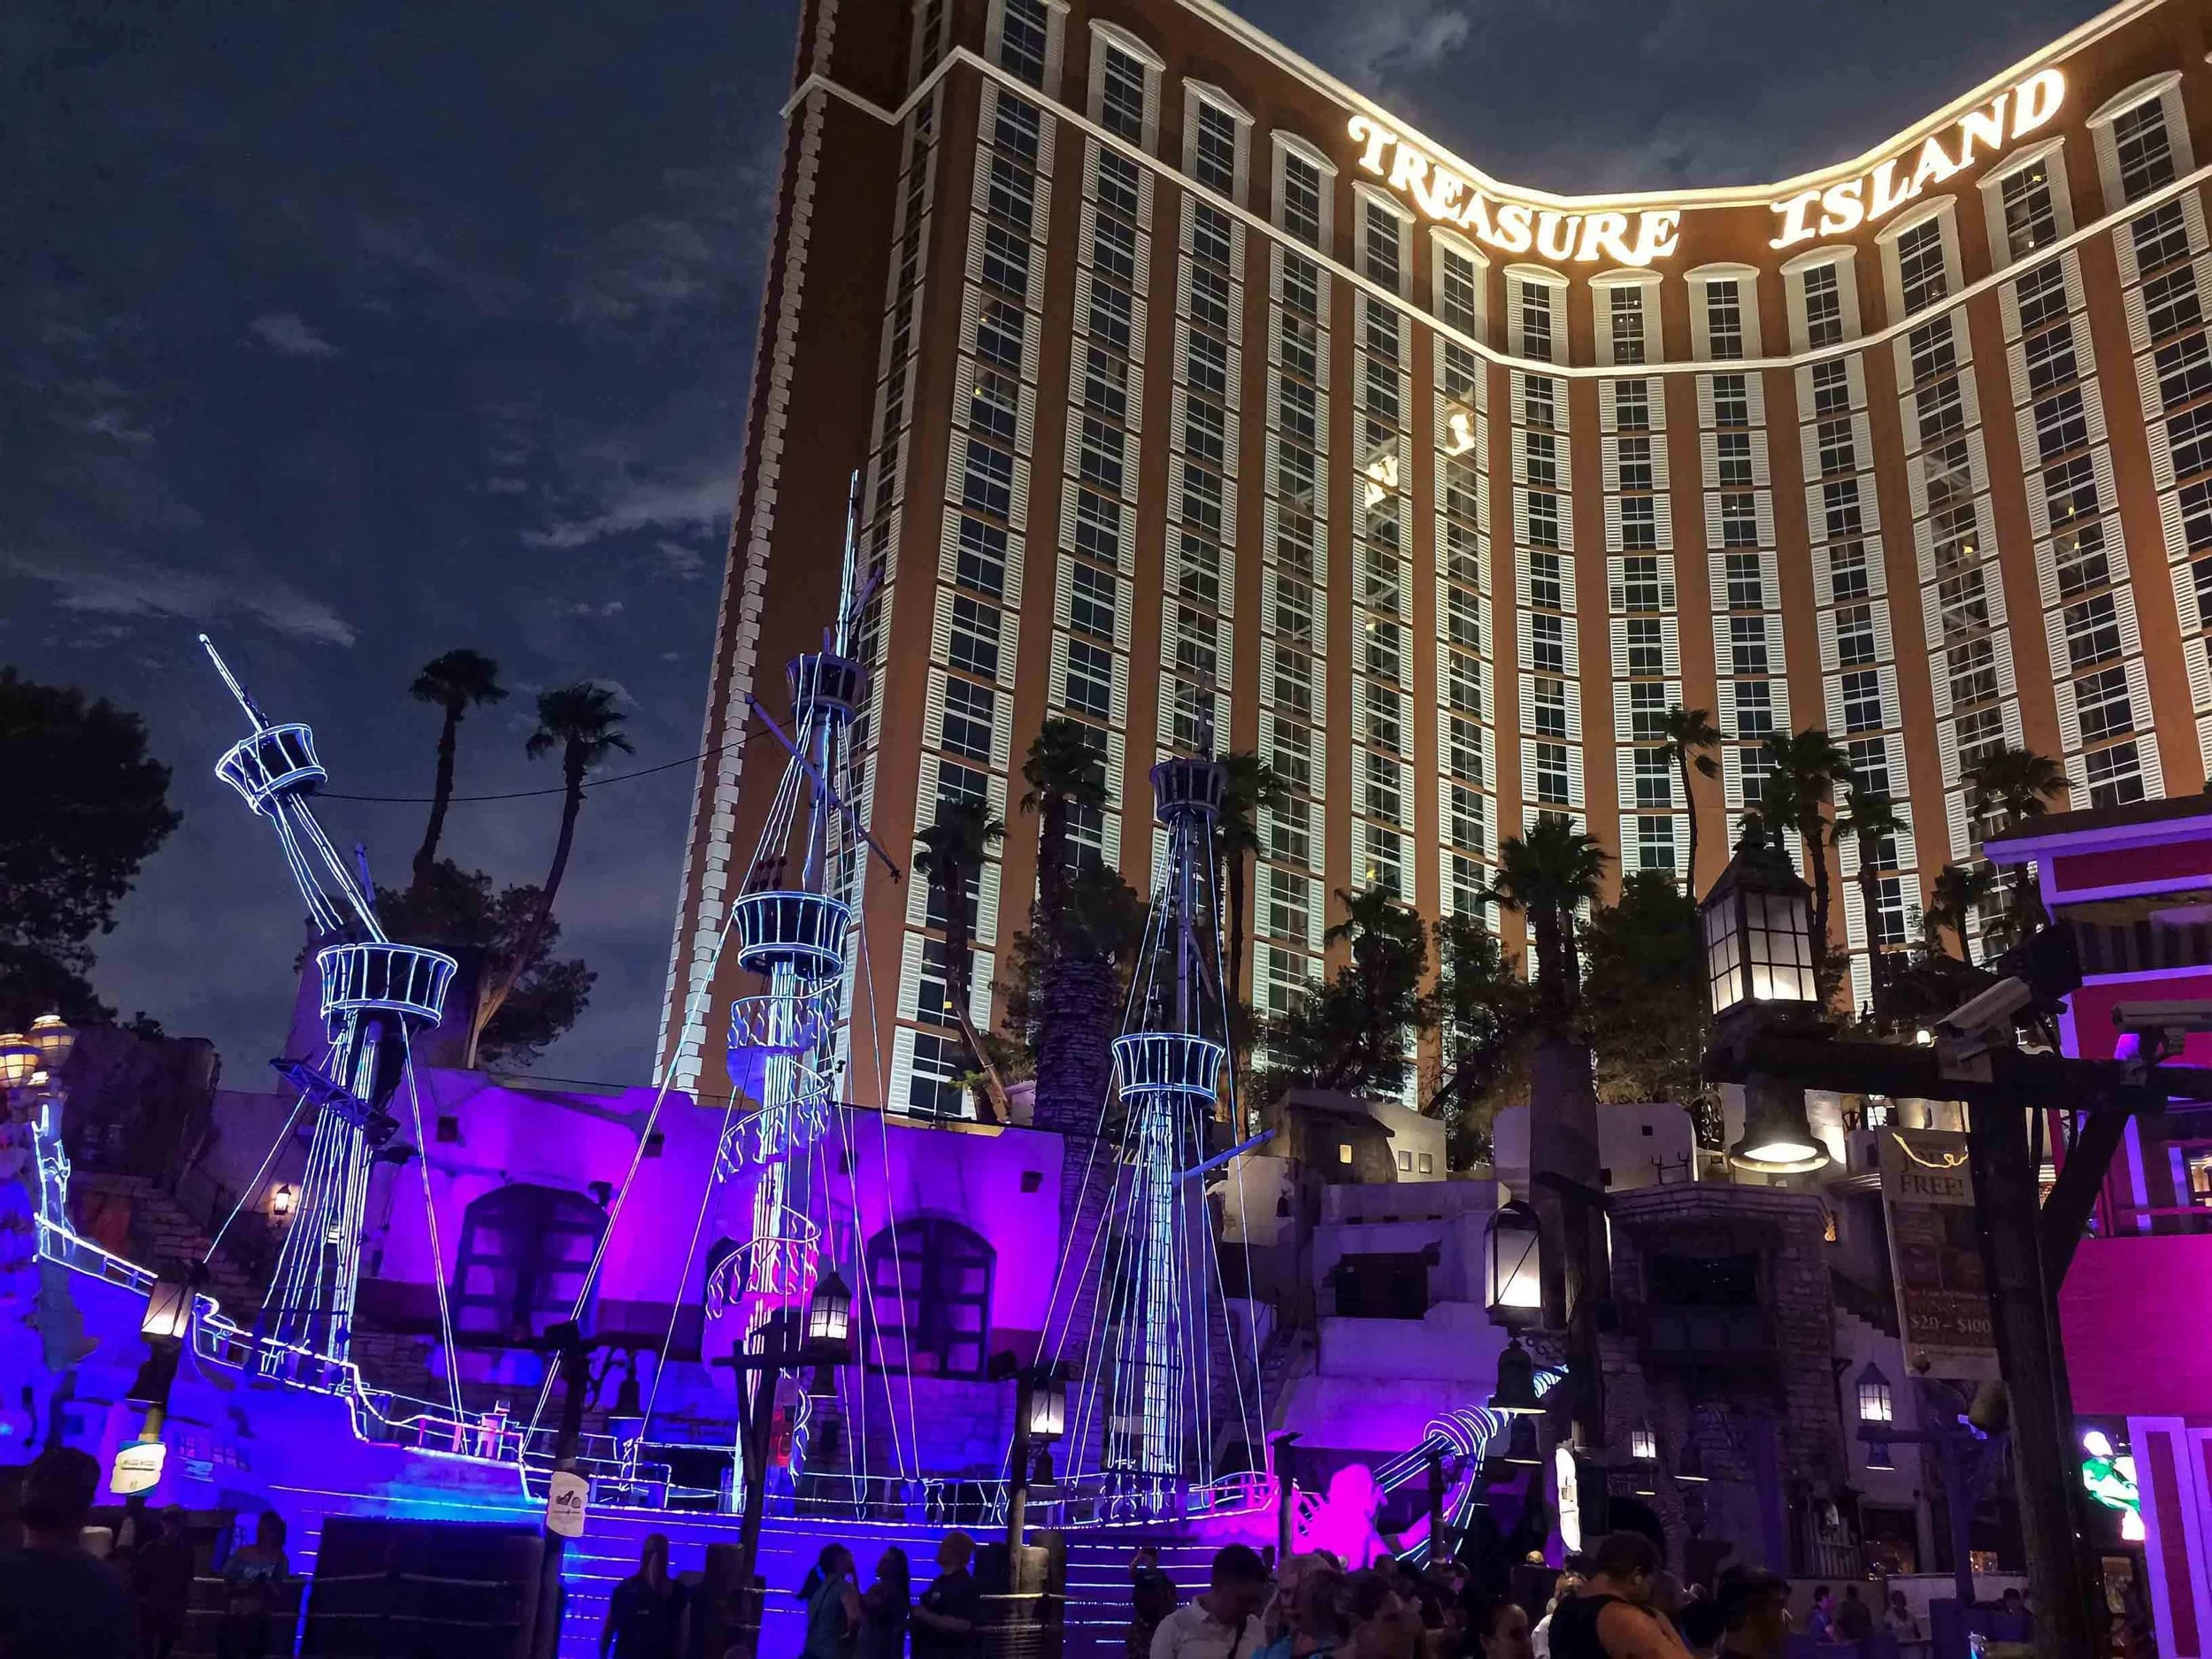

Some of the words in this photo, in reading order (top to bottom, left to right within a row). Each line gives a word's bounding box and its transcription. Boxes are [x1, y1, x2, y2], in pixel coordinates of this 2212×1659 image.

[1347, 114, 1682, 266] TREASURE
[1769, 67, 2066, 250] ISLAND
[1901, 1175, 1963, 1196] FREE!
